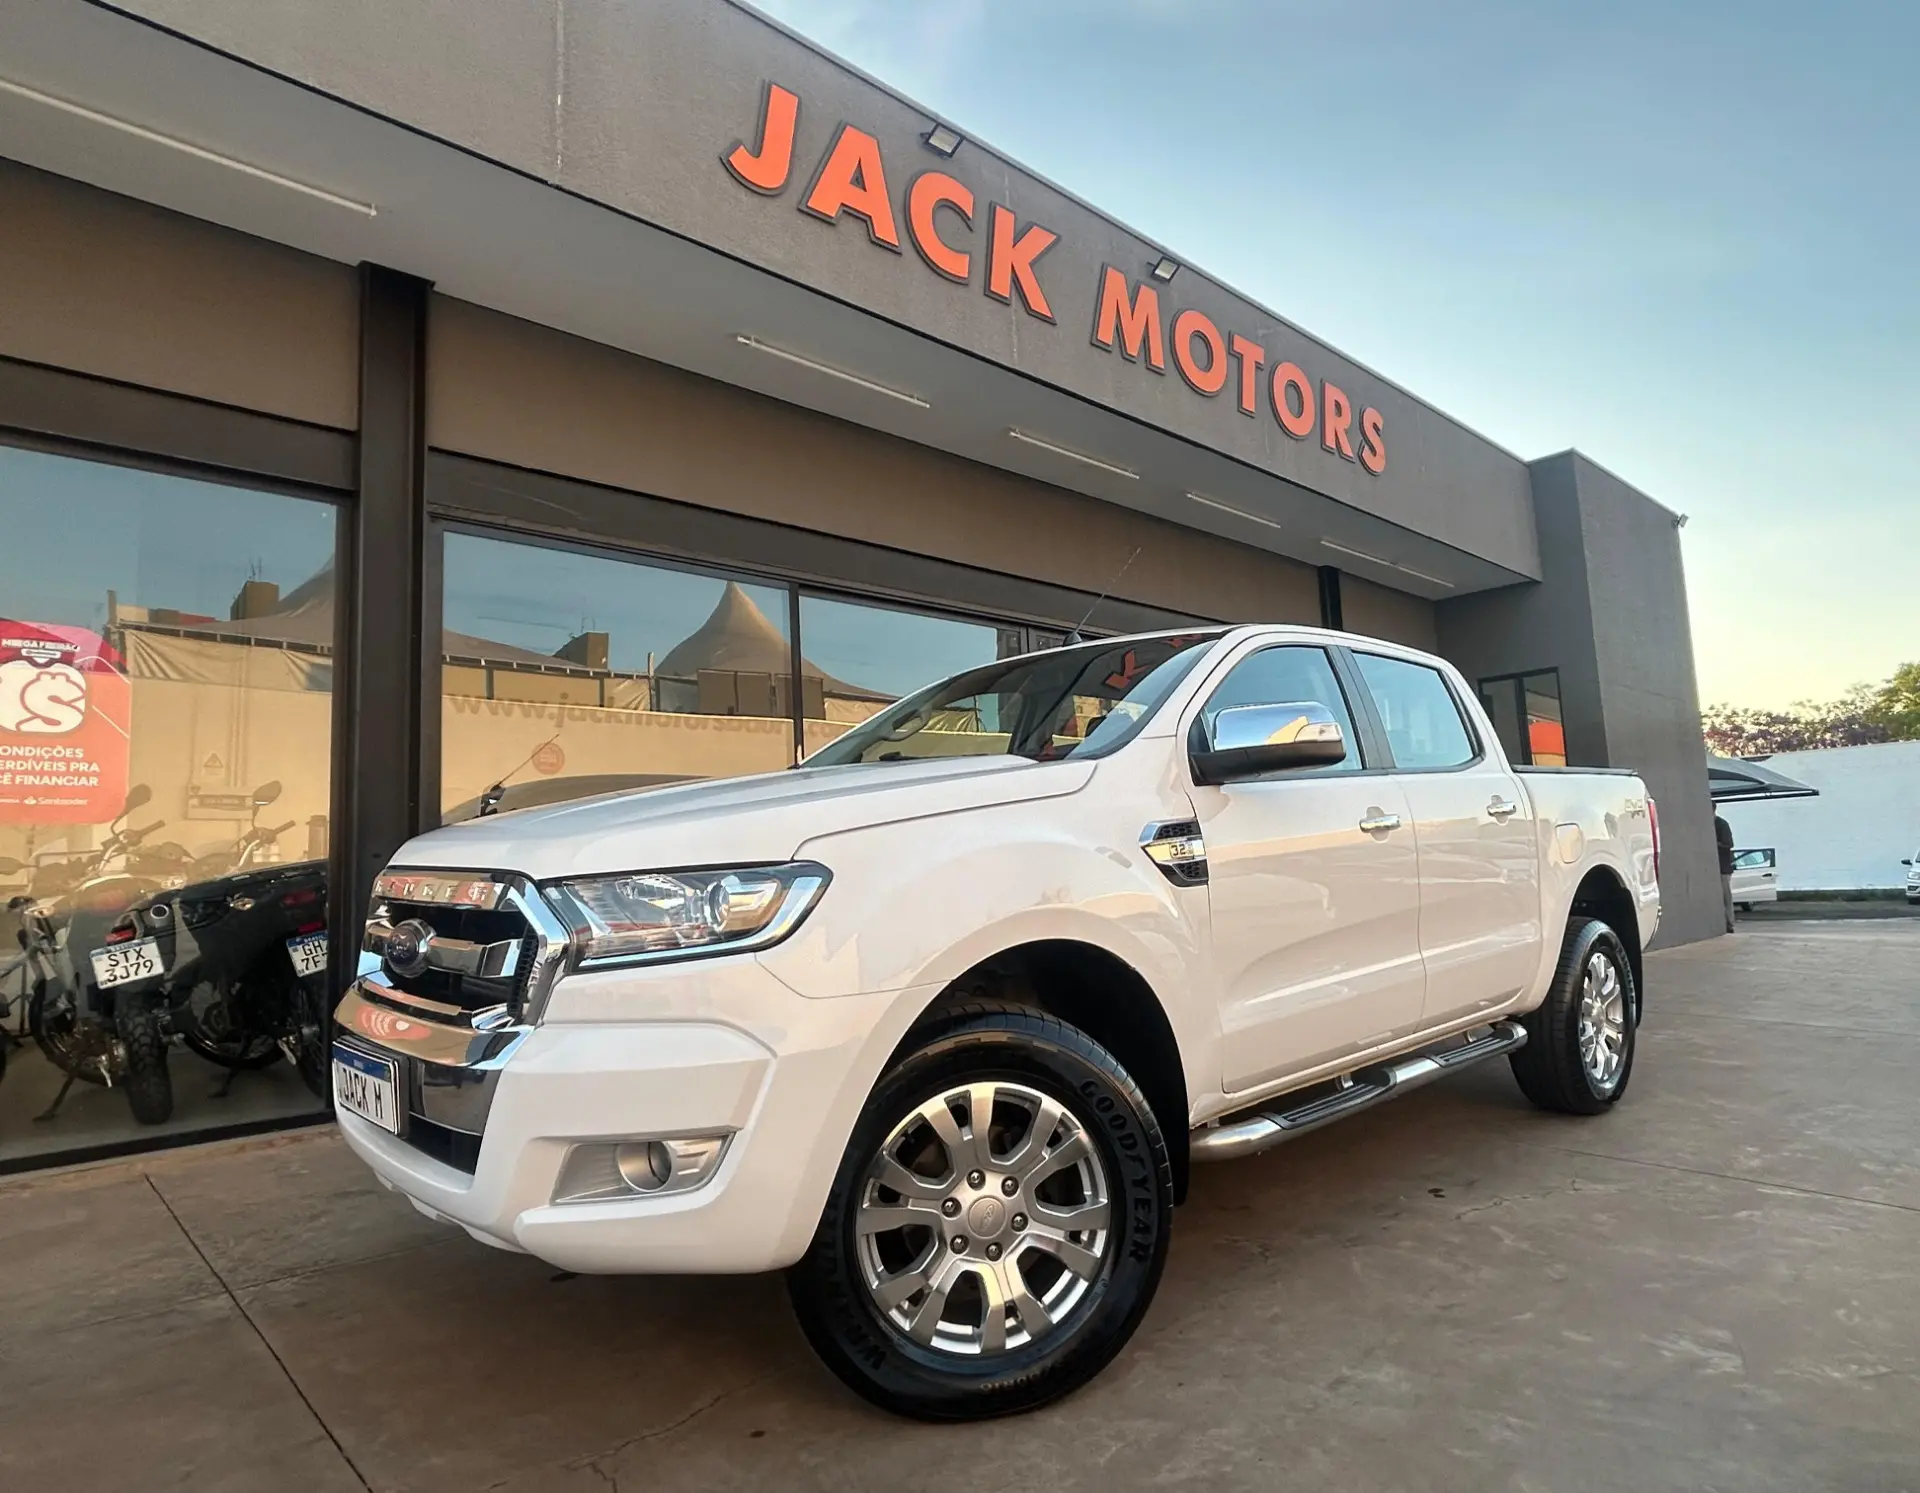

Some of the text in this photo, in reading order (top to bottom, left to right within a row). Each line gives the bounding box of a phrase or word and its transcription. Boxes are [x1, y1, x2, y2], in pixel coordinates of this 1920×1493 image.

[725, 83, 1385, 474] JACK MOTORS
[70, 762, 100, 773] PRA
[15, 775, 100, 787] FINANCIAR
[108, 947, 145, 967] STX
[302, 941, 328, 956] GH
[105, 959, 153, 982] 3J79
[343, 1067, 369, 1113] JACK
[1076, 1077, 1159, 1262] GOODYEAR
